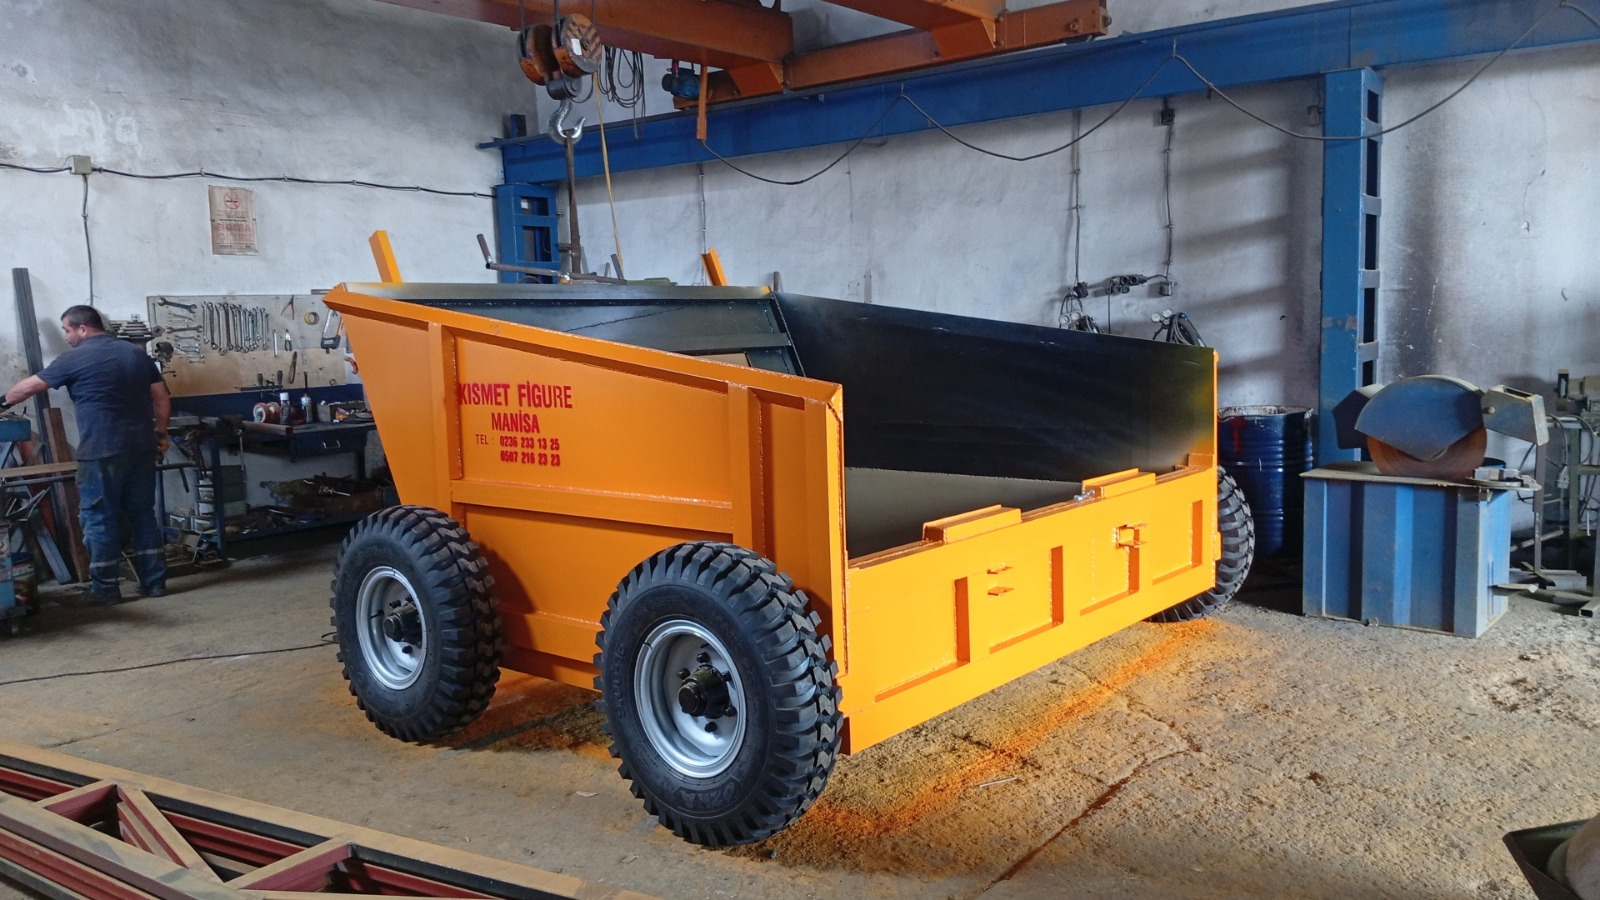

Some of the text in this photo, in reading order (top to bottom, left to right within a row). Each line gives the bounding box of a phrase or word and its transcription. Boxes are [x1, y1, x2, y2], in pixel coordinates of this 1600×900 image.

[458, 381, 573, 409] KISMET FİGURE
[491, 410, 540, 434] MANİSA
[500, 435, 518, 448] 0236
[521, 437, 535, 449] 233
[537, 438, 548, 451] 13
